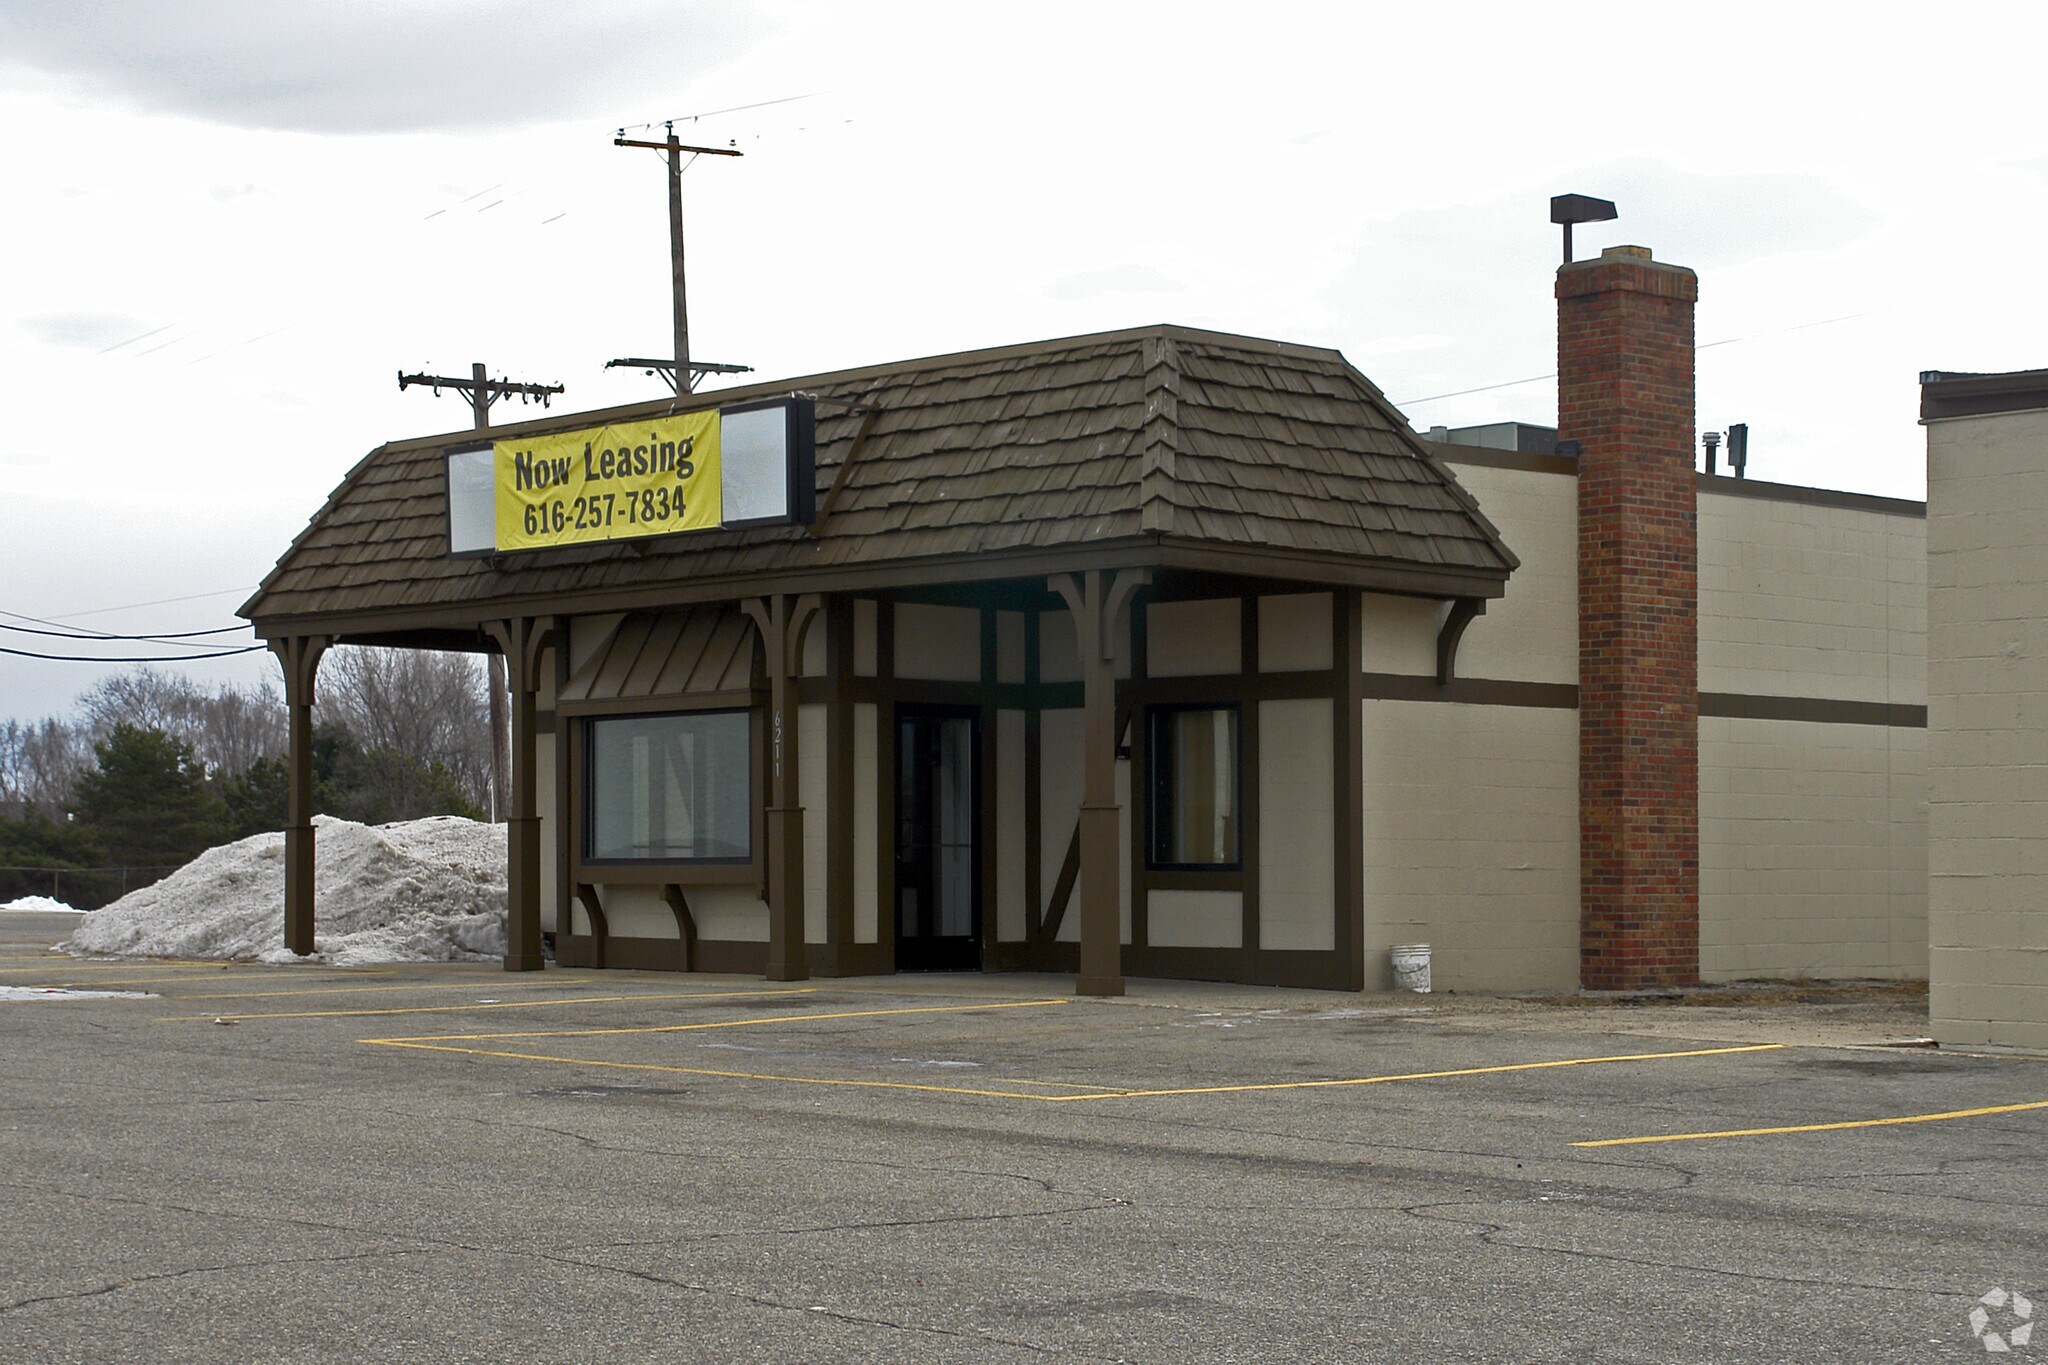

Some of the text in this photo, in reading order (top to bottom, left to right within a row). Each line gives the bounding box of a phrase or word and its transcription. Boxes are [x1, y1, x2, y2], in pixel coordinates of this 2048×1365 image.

[515, 433, 694, 491] Now Leasing
[524, 485, 686, 535] 616-257-7834
[774, 710, 782, 778] 6211
